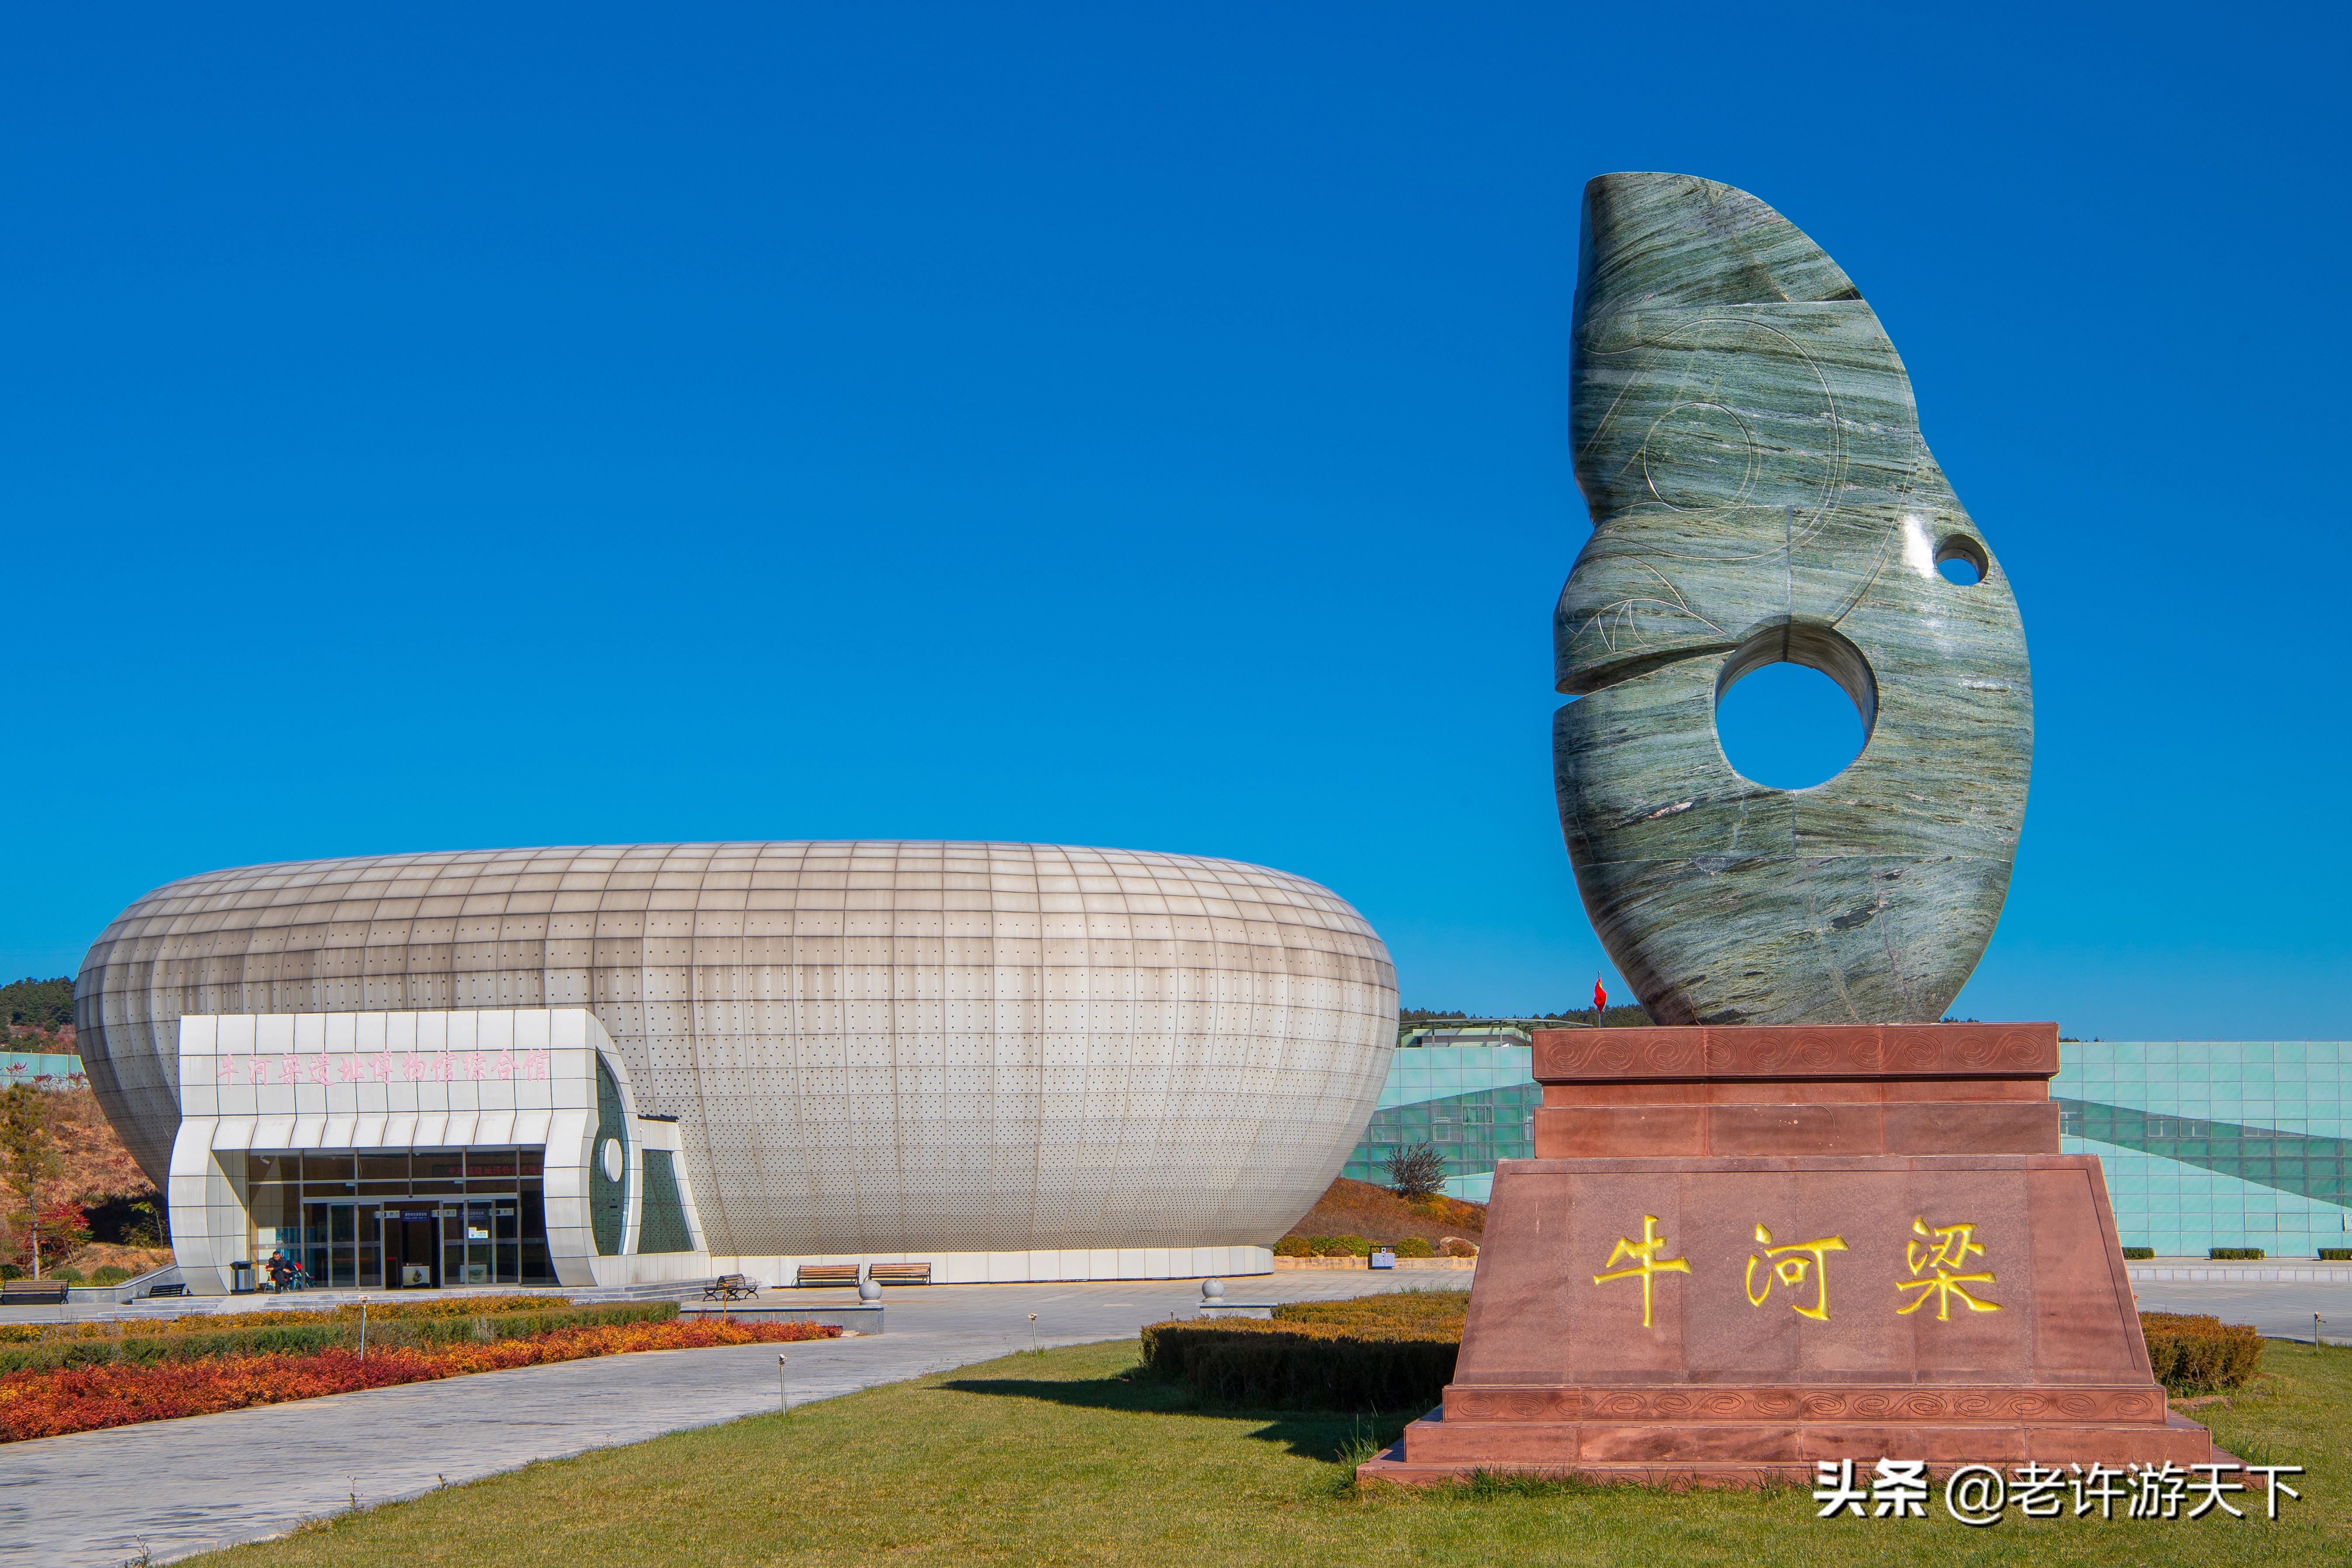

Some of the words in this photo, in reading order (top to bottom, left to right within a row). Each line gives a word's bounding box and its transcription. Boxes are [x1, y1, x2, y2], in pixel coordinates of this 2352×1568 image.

[216, 1048, 551, 1090] 牛河梁遗址博物馆综合馆
[1593, 1215, 2003, 1328] 牛河梁
